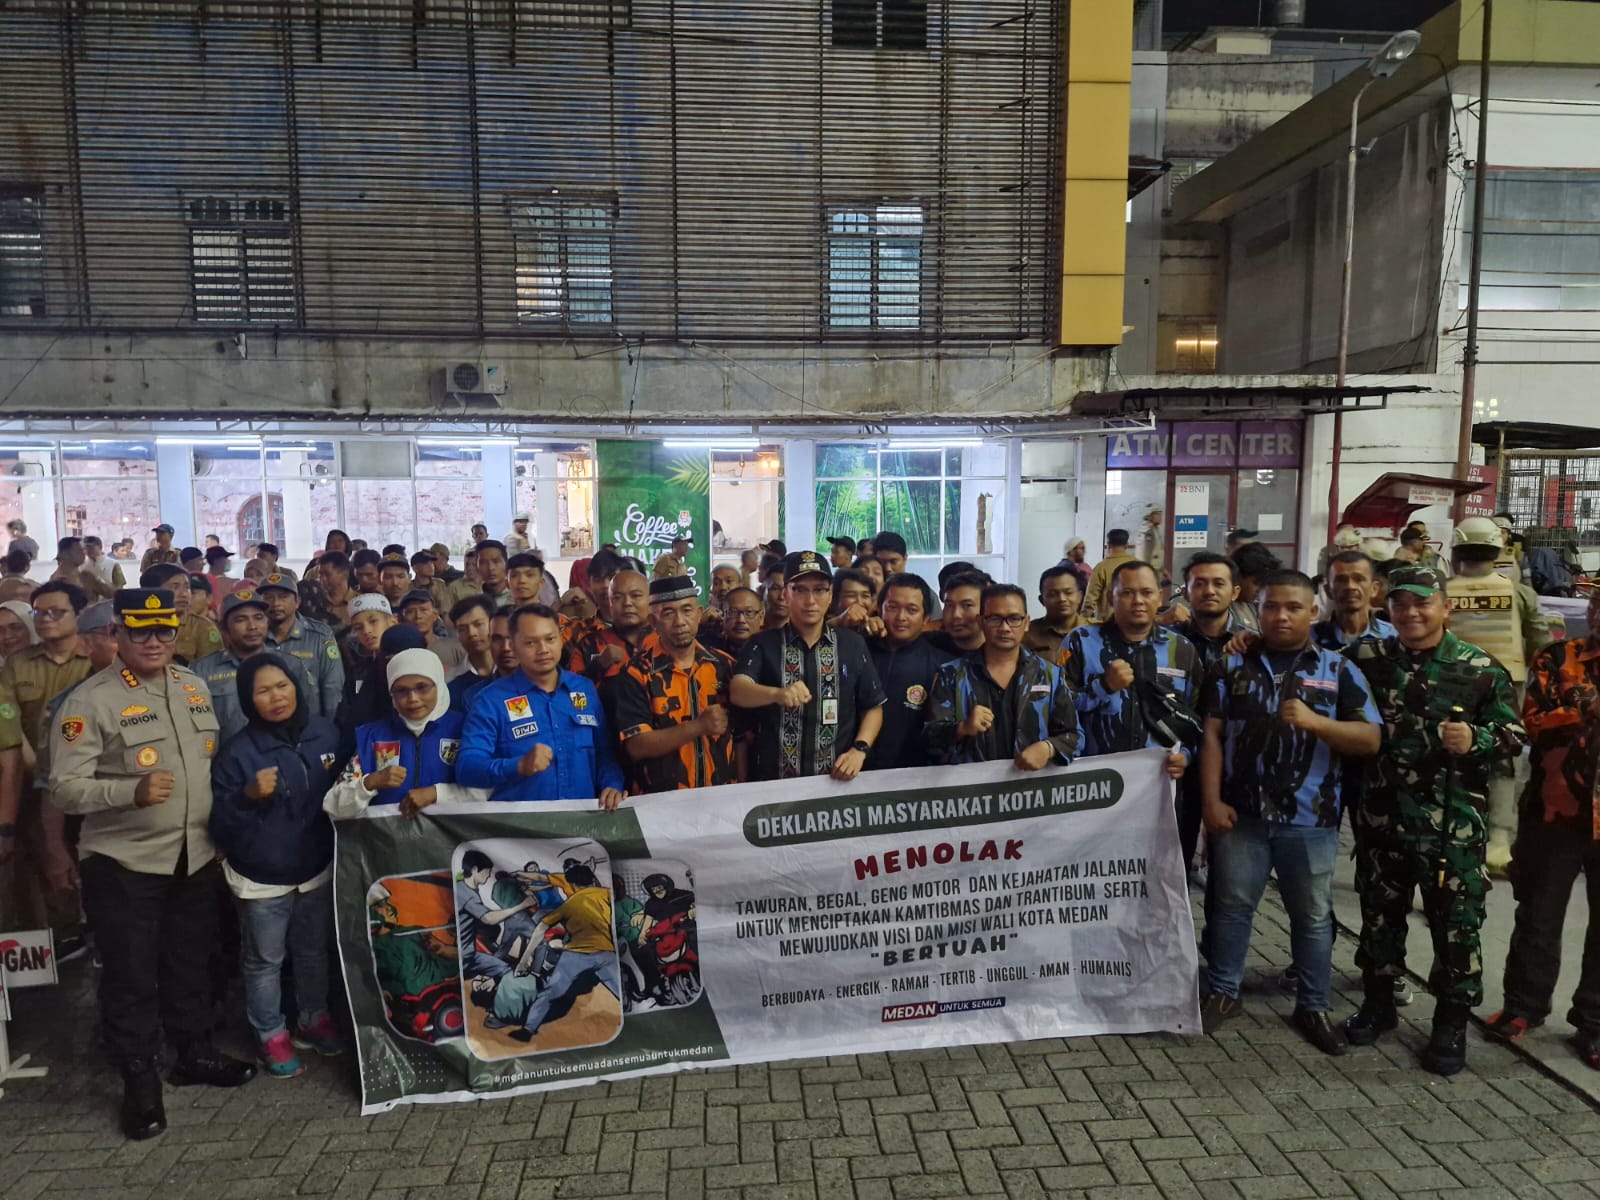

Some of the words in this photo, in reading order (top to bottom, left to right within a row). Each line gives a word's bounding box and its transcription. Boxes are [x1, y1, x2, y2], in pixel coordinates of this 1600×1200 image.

[1112, 434, 1177, 457] ATM
[1187, 434, 1294, 456] CENTER
[1188, 485, 1205, 493] BNI
[622, 503, 678, 546] Coffee
[1465, 506, 1493, 516] DIATOR
[120, 713, 158, 728] GIDION
[514, 723, 537, 737] DIWA
[757, 807, 861, 839] DEKLARASI
[867, 795, 992, 826] MASYARAKAT
[998, 789, 1045, 814] KOTA
[1051, 780, 1112, 806] MEDAN
[854, 839, 1024, 880] MENOLAK
[736, 896, 812, 916] TAWURAN,
[817, 891, 867, 910] BEGAL,
[871, 885, 907, 905] GENG
[912, 878, 961, 900] MOTOR
[969, 873, 998, 893] DAN
[1001, 863, 1079, 891] KEJAHATAN
[1083, 858, 1147, 878] JALANAN
[736, 918, 784, 939] UNTUK
[788, 908, 891, 934] MENCIPTAKAN
[895, 898, 980, 922] KAMTIBMAS
[985, 894, 1012, 913] DAN
[1016, 883, 1096, 907] TRANTIBUM
[1103, 880, 1149, 899] SERTA
[779, 931, 879, 957] MEWUJUDKAN
[883, 927, 911, 946] VISI
[915, 924, 943, 943] DAN
[947, 919, 977, 938] MISI
[981, 913, 1014, 932] WALI
[1018, 909, 1055, 928] KOTA
[1058, 904, 1108, 924] MEDAN
[0, 945, 46, 972] GAN
[870, 933, 1018, 967] "BERTUAH"
[761, 989, 825, 1008] BERBUDAYA
[836, 980, 881, 999] ENERGIK
[891, 975, 929, 993] RAMAH
[940, 969, 976, 986] TERTIB
[987, 966, 1029, 983] UNGGUL
[1039, 961, 1070, 979] AMAN
[1080, 960, 1132, 977] HUMANIS
[883, 1003, 936, 1020] MEDAN
[939, 1002, 969, 1013] UNTUK
[971, 998, 1002, 1009] SEMUA
[494, 1045, 714, 1084] #medanuntuksemuadansemuauntukmedan
